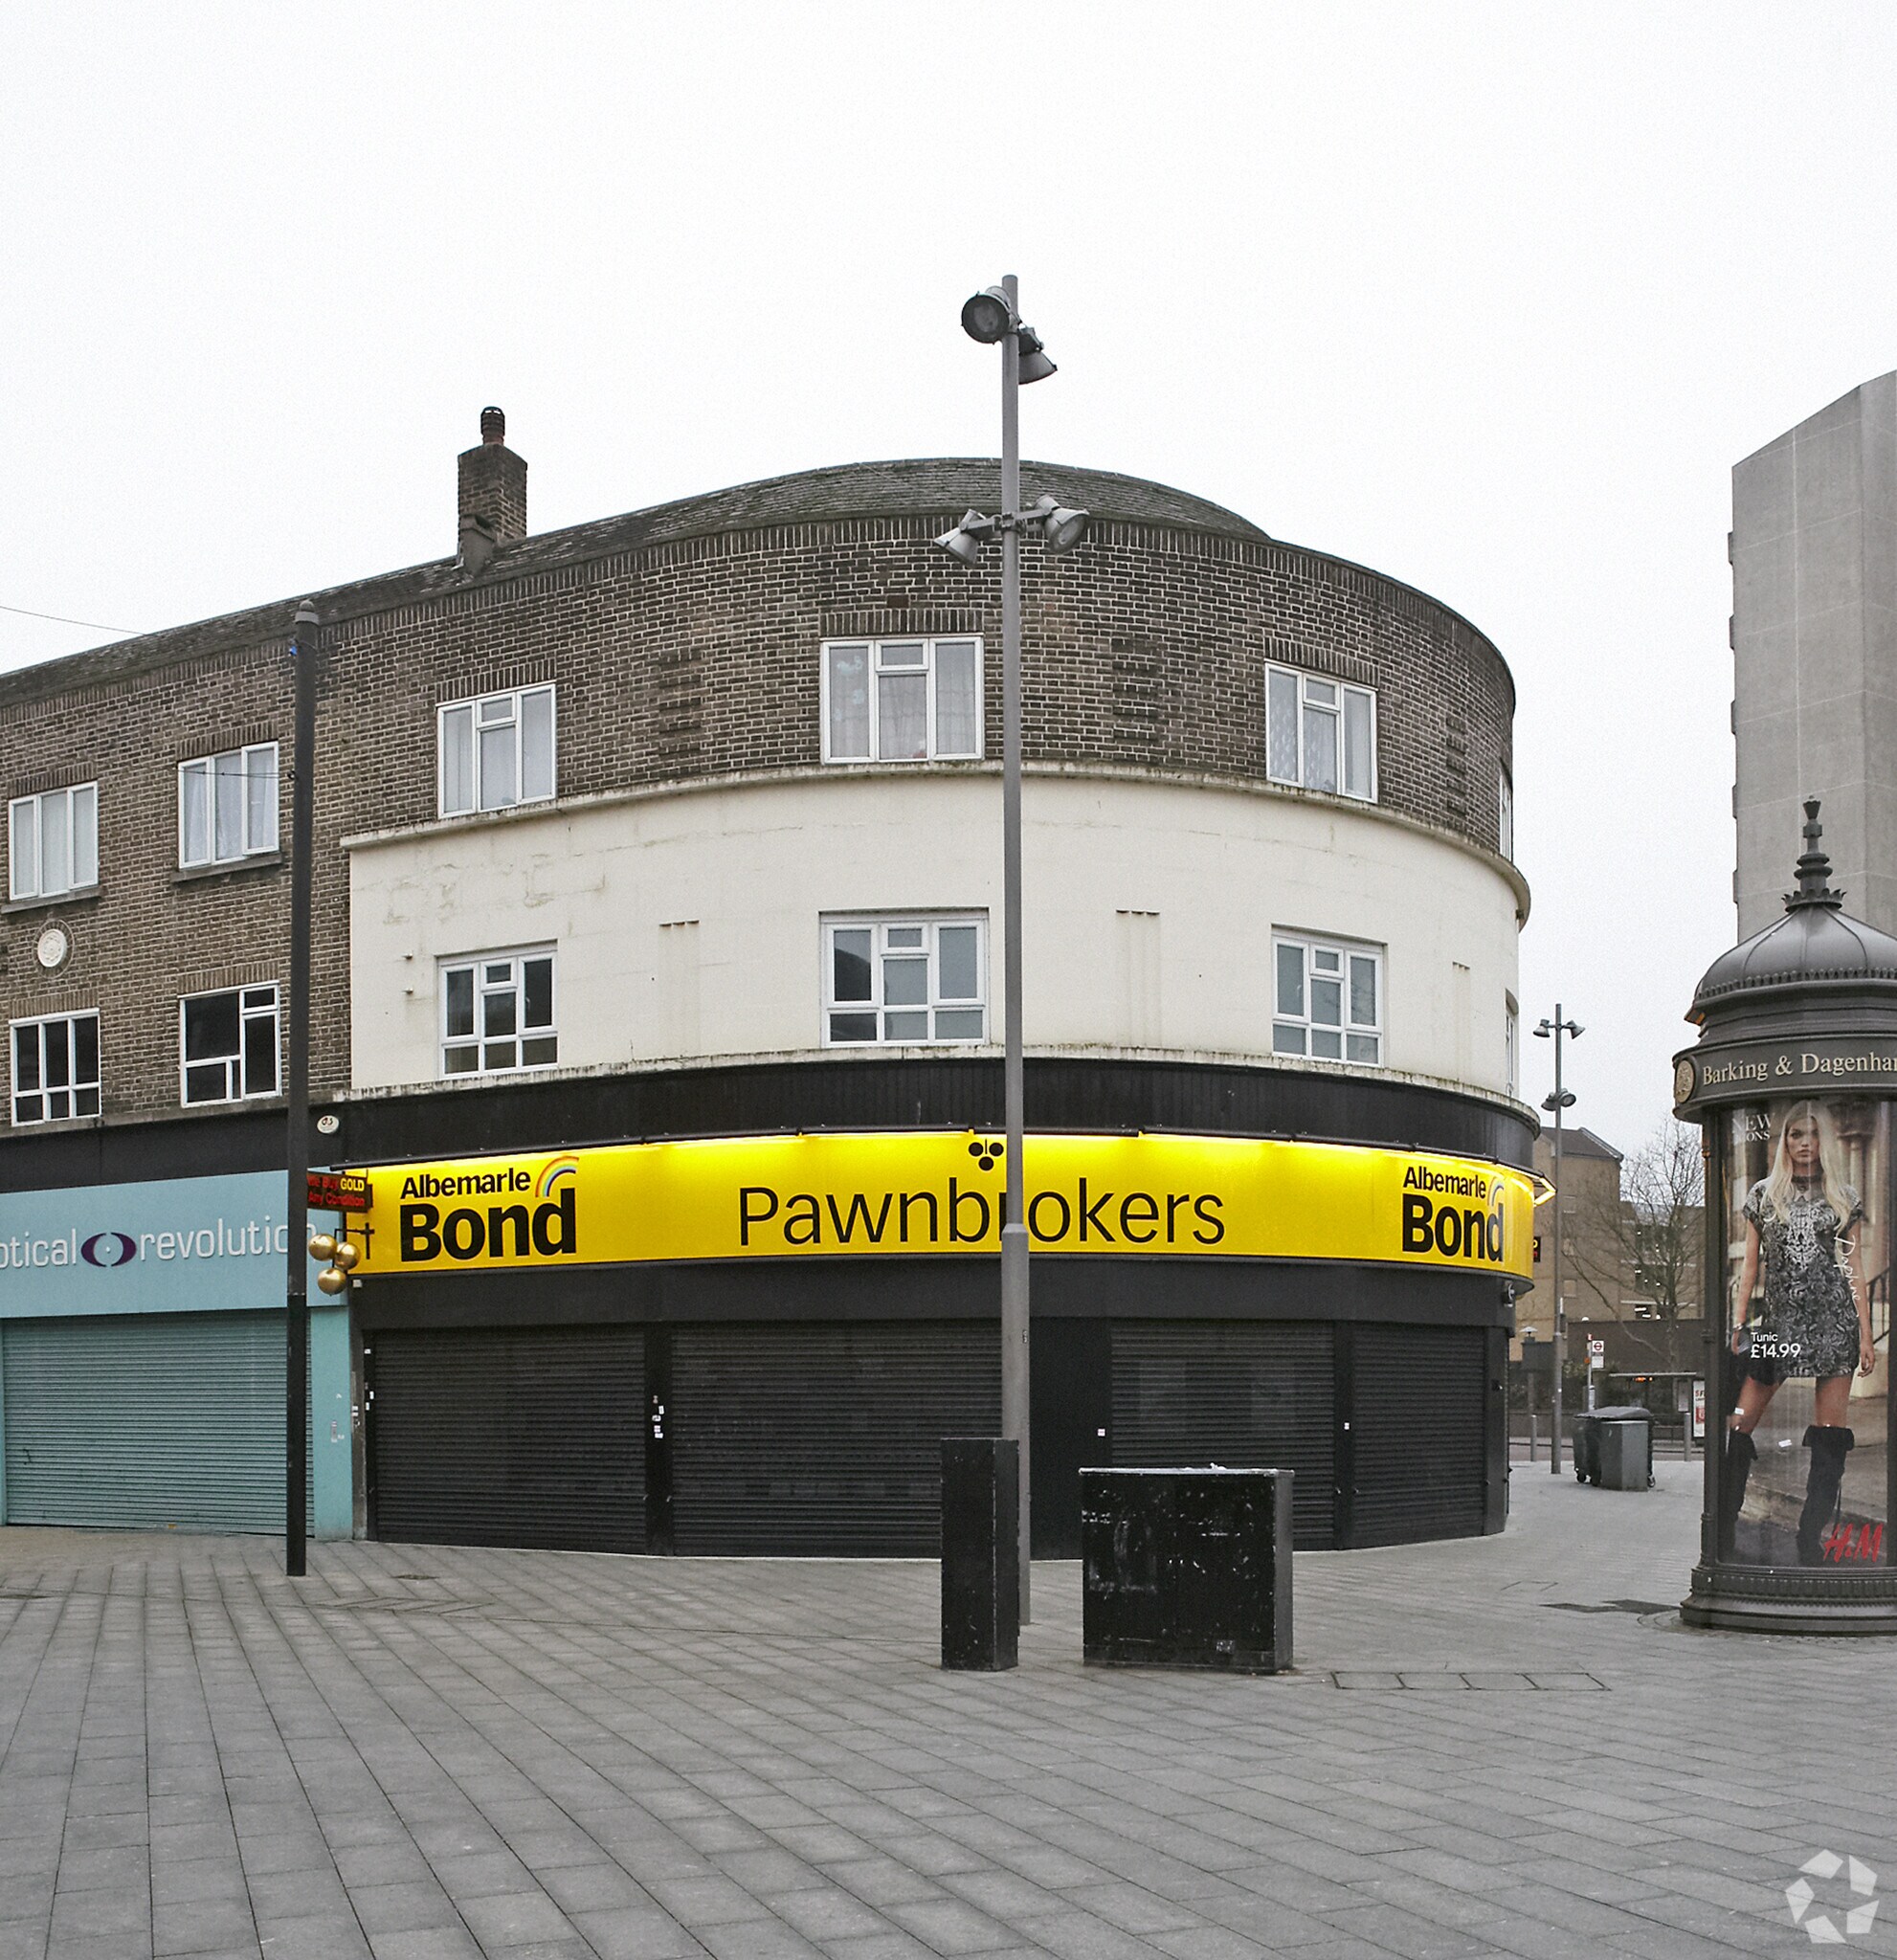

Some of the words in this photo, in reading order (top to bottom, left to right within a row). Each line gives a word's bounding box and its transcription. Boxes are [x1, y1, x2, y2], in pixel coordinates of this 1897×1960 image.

[1703, 1059, 1769, 1086] Barking
[1775, 1056, 1793, 1075] &
[340, 1177, 365, 1192] GOLD
[400, 1168, 531, 1199] Albemarle
[1403, 1166, 1486, 1199] Albemarle
[141, 1214, 316, 1260] revolutio
[400, 1188, 576, 1262] Bond
[1402, 1192, 1504, 1261] Bond
[1834, 1234, 1861, 1318] Daphne
[1751, 1332, 1778, 1342] Tunic
[1751, 1343, 1801, 1359] £14.99
[1822, 1523, 1884, 1563] H&M
